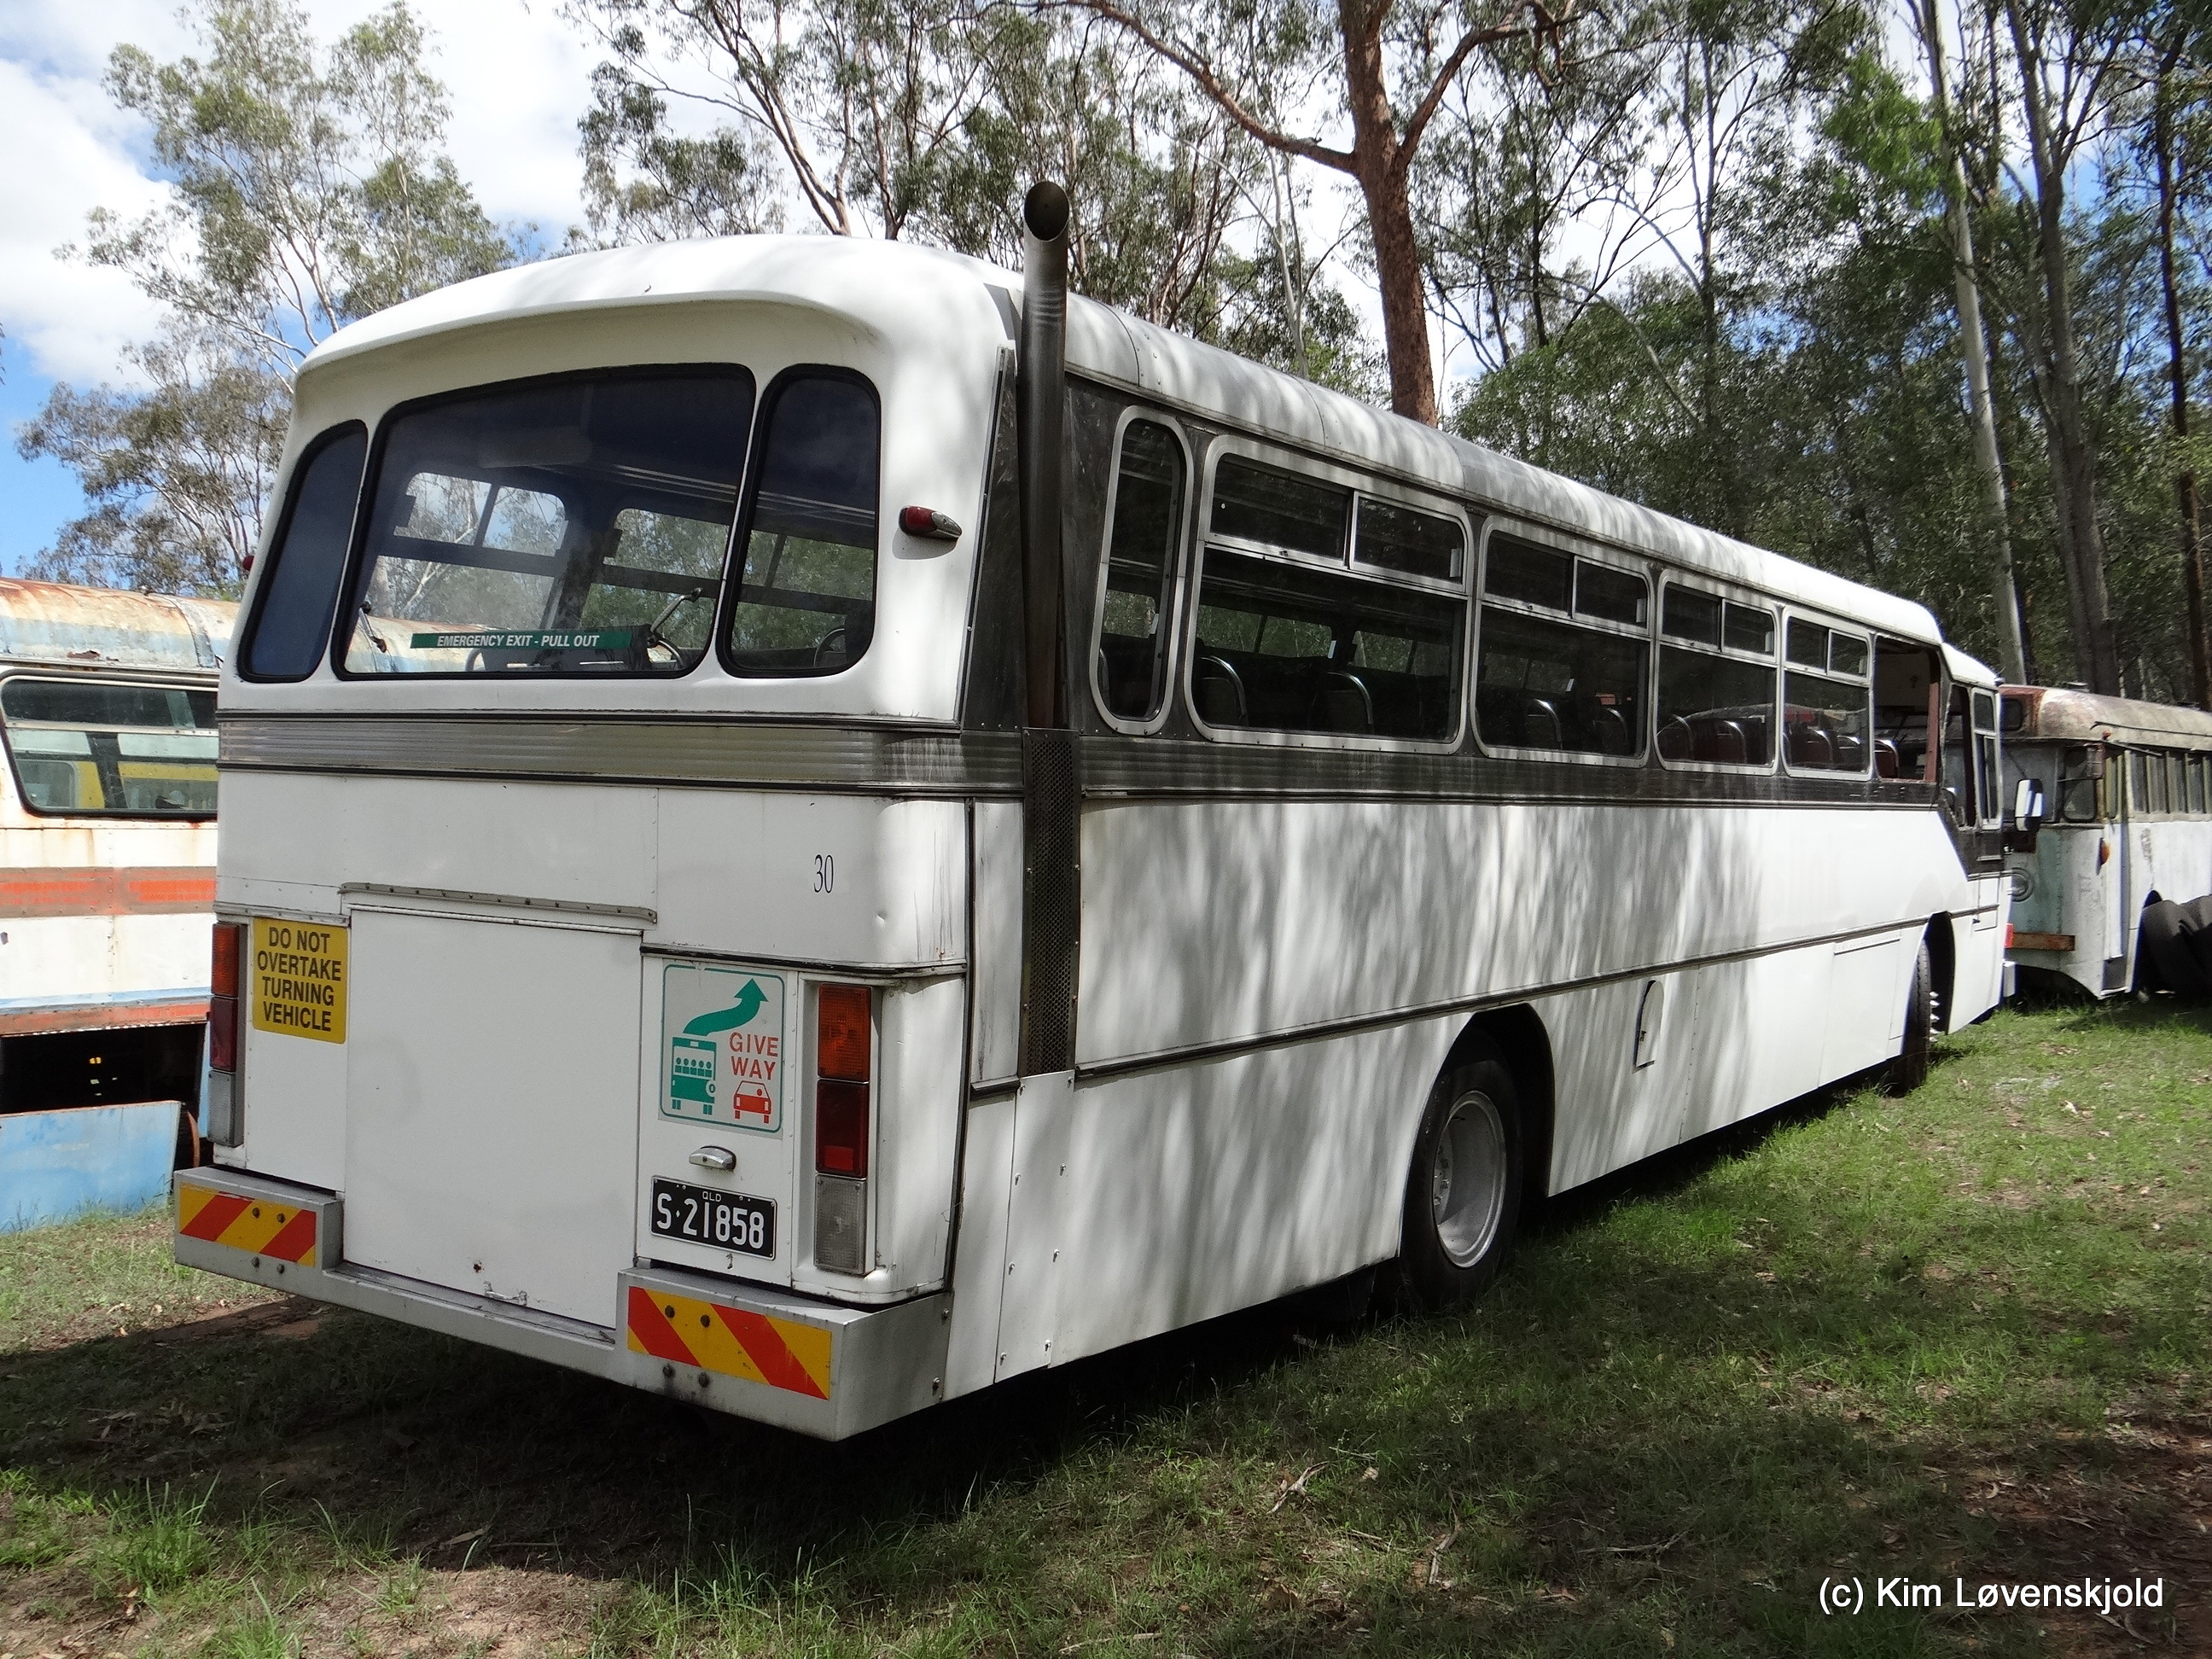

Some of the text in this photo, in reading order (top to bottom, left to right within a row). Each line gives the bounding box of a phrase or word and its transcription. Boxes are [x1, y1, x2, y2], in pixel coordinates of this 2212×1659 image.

[437, 635, 504, 647] EMERGENCY
[506, 635, 533, 647] EXIT
[541, 635, 570, 647] PULL
[573, 635, 599, 647] OUT
[813, 854, 834, 894] 30
[269, 927, 330, 954] DO NOT
[257, 951, 341, 981] OVERTAKE
[262, 976, 335, 1007] TURNING
[263, 1001, 332, 1032] VEHICLE
[729, 1032, 779, 1057] GIVE
[731, 1056, 776, 1080] WAY
[702, 1190, 722, 1202] QLD
